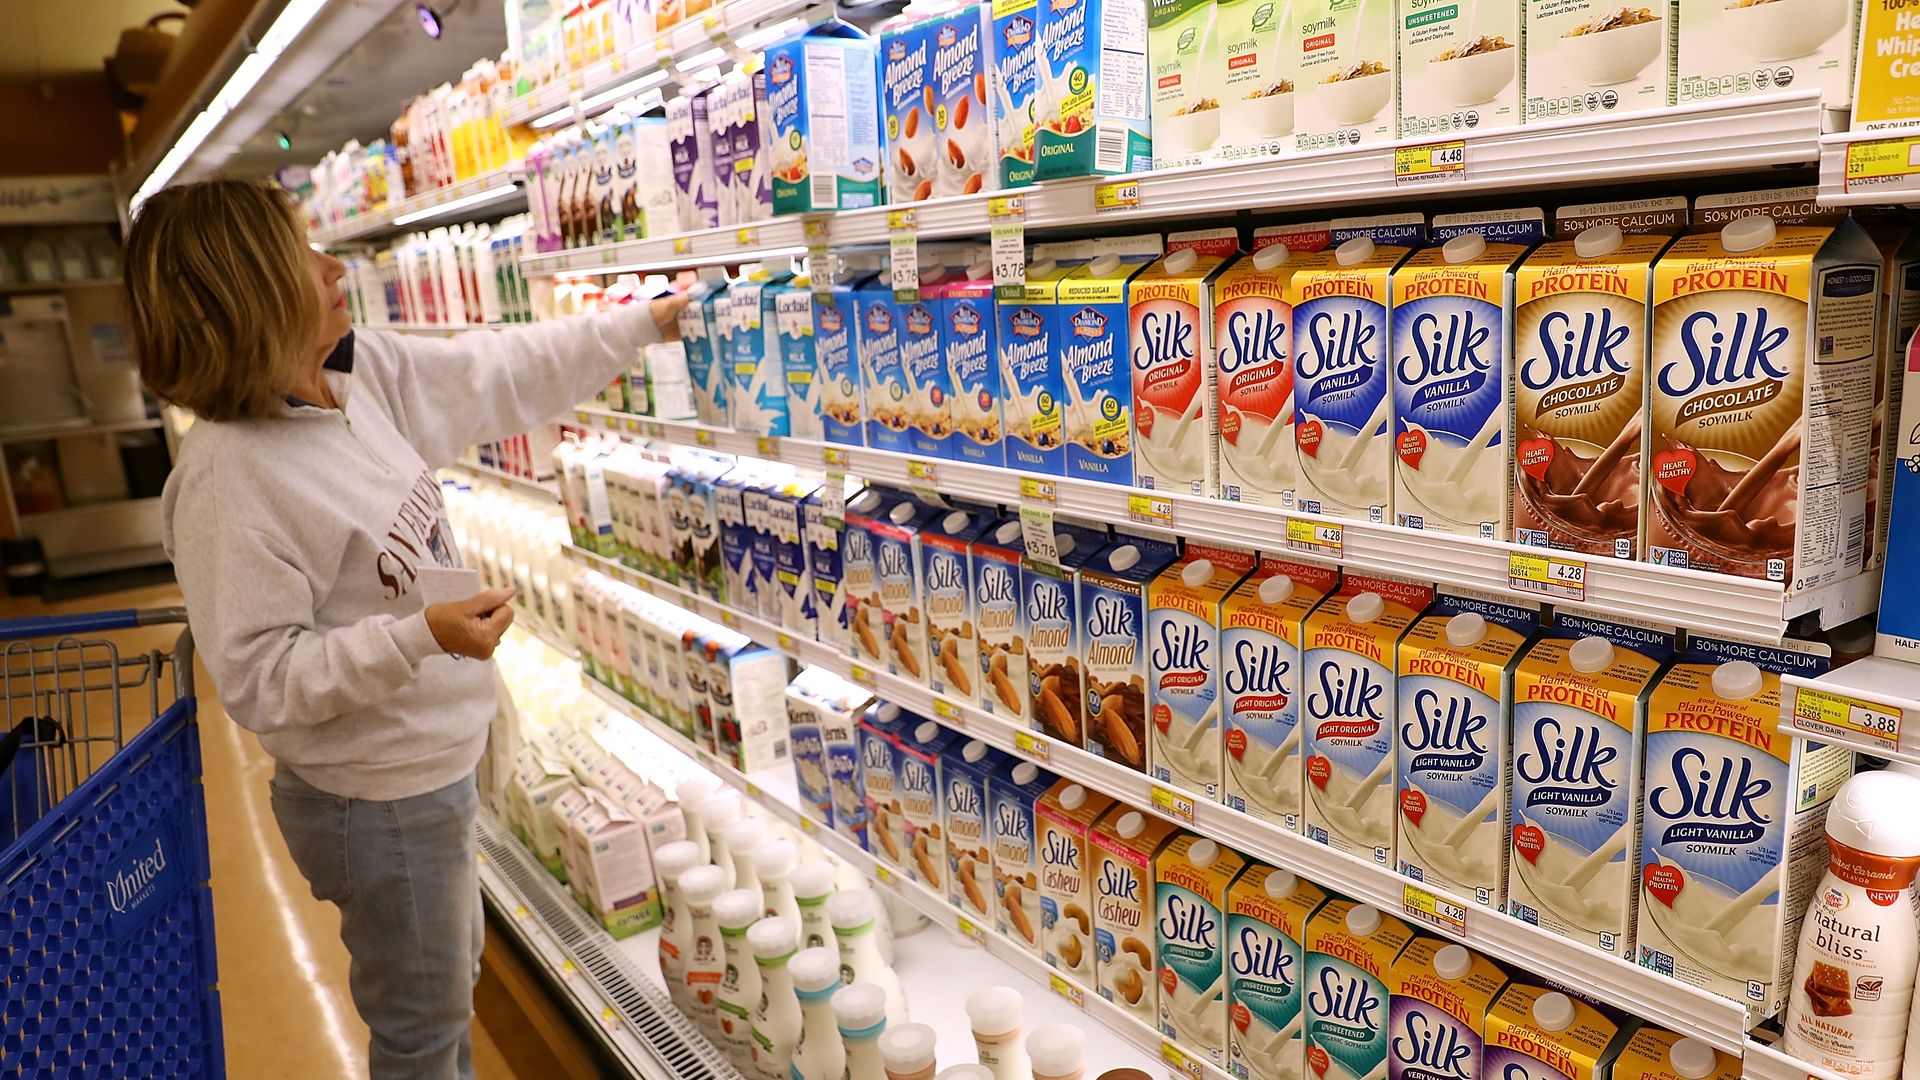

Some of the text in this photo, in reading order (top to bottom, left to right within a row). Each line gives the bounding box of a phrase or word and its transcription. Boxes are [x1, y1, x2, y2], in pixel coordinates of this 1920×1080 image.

[1153, 4, 1182, 17] ORGANIC
[1408, 10, 1454, 25] UNSWEETENED
[1042, 1, 1085, 47] Almond
[1302, 17, 1336, 35] soymilk
[1053, 26, 1084, 62] Breeze
[1227, 38, 1258, 54] soymilk
[1305, 38, 1332, 49] ORIGINAL
[933, 24, 977, 81] Almond
[885, 40, 926, 93] Almond
[1229, 57, 1254, 67] ORIGINAL
[1041, 143, 1074, 157] ORIGINAL
[1441, 149, 1462, 163] 4.48
[1849, 163, 1864, 173] 321
[1122, 187, 1137, 199] 4.48
[1704, 211, 1728, 223] 50%
[1335, 230, 1351, 241] 50%
[1377, 227, 1417, 238] CALCIUM
[1439, 230, 1457, 239] 50%
[1488, 224, 1532, 235] CALCIUM
[996, 262, 1025, 278] $3.78
[1222, 282, 1284, 299] PROTEIN
[1302, 280, 1374, 299] PROTEIN
[1405, 279, 1487, 301] PROTEIN
[1531, 273, 1628, 297] PROTEIN
[1672, 269, 1788, 296] PROTEIN
[1136, 284, 1190, 301] PROTEIN
[1133, 309, 1194, 370] Silk
[1218, 308, 1287, 373] Silk
[1296, 309, 1377, 379] Silk
[1397, 310, 1492, 386] Silk
[1005, 332, 1049, 367] Almond
[1066, 333, 1113, 372] Almond
[1520, 308, 1632, 390] Silk
[1657, 307, 1790, 397] Silk
[1020, 356, 1048, 380] Breeze
[1082, 356, 1114, 385] Breeze
[1148, 365, 1185, 381] ORIGINAL
[1235, 366, 1276, 385] ORIGINAL
[1152, 380, 1178, 392] SOYMILK
[1319, 371, 1360, 391] VANILLA
[1424, 380, 1471, 399] VANILLA
[1240, 383, 1269, 397] SOYMILK
[1322, 389, 1356, 405] SOYMILK
[1542, 378, 1618, 409] CHOCOLATE
[1426, 398, 1466, 413] SOYMILK
[1683, 382, 1775, 417] CHOCOLATE
[1555, 402, 1601, 419] SOYMILK
[1698, 411, 1753, 429] SOYMILK
[1017, 451, 1044, 464] VANILLA
[1522, 455, 1550, 466] HEALTHY
[1525, 448, 1546, 458] HEART
[1079, 459, 1109, 472] VANILLA
[1659, 467, 1691, 479] HEALTHY
[1662, 460, 1687, 471] HEART
[1157, 503, 1171, 514] 4.28
[1322, 529, 1340, 542] 4.28
[1532, 532, 1547, 540] NON
[1532, 537, 1547, 546] GMO
[1026, 541, 1056, 557] $3.78
[1616, 541, 1629, 549] 120
[1669, 551, 1686, 559] NON
[1669, 557, 1686, 565] GMO
[1558, 566, 1581, 580] 4.28
[1768, 562, 1783, 570] 120
[1081, 574, 1140, 595] DARK CHOCOLATE
[1348, 577, 1424, 597] 50% MORE CALCIUM
[1029, 582, 1067, 620] Silk
[1443, 597, 1531, 621] 50% MORE CALCIUM
[1089, 595, 1133, 638] Silk
[1230, 613, 1288, 638] PROTEIN
[1088, 636, 1134, 666] Almond
[1152, 620, 1210, 672] Silk
[1314, 633, 1381, 661] PROTEIN
[1895, 639, 1919, 649] HALF
[1696, 640, 1817, 669] 50% MORE CALCIUM
[1225, 639, 1291, 695] Silk
[1409, 659, 1485, 691] PROTEIN
[1161, 674, 1204, 684] LIGHT ORIGINAL
[1307, 660, 1384, 720] Silk
[1236, 698, 1284, 709] LIGHT ORIGINAL
[1528, 685, 1617, 721] PROTEIN
[1246, 712, 1274, 720] SOYMILK
[1401, 689, 1488, 754] Silk
[1864, 713, 1895, 733] 3.88
[1319, 722, 1376, 735] LIGHT ORIGINAL
[1665, 712, 1771, 751] PROTEIN
[1797, 719, 1846, 736] CLOVER DAIRY
[1330, 738, 1362, 747] SOYMILK
[1517, 717, 1618, 789] Silk
[1415, 757, 1476, 767] LIGHT VANILLA
[1426, 772, 1464, 782] SOYMILK
[1649, 747, 1772, 825] Silk
[1533, 792, 1602, 802] LIGHT VANILLA
[1545, 806, 1588, 818] SOYMILK
[1670, 827, 1754, 840] LIGHT VANILLA
[1042, 830, 1079, 870] Silk
[1686, 844, 1737, 856] SOYMILK
[106, 837, 166, 913] United
[1652, 875, 1676, 885] HEALTHY
[1655, 870, 1673, 878] HEART
[1843, 872, 1870, 884] FLAVOR
[1852, 865, 1896, 880] Caramel
[1098, 860, 1139, 903] Silk
[1649, 881, 1679, 892] PROTEIN
[1870, 893, 1897, 901] NEW!
[1098, 897, 1140, 927] Cashew
[1444, 905, 1464, 921] 4.28
[1160, 894, 1215, 949] Silk
[1814, 911, 1880, 942] natural
[1816, 928, 1863, 960] bliss
[1231, 927, 1294, 985] Silk
[1315, 940, 1380, 976] PROTEIN
[1242, 981, 1282, 994] UNSWEETENED
[1308, 966, 1380, 1030] Silk
[1400, 982, 1470, 1024] PROTEIN
[1321, 1024, 1365, 1039] UNSWEETENED
[1801, 1014, 1853, 1040] ALL NATURAL
[1393, 1010, 1471, 1079] Silk
[1497, 1032, 1578, 1079] PROTEIN
